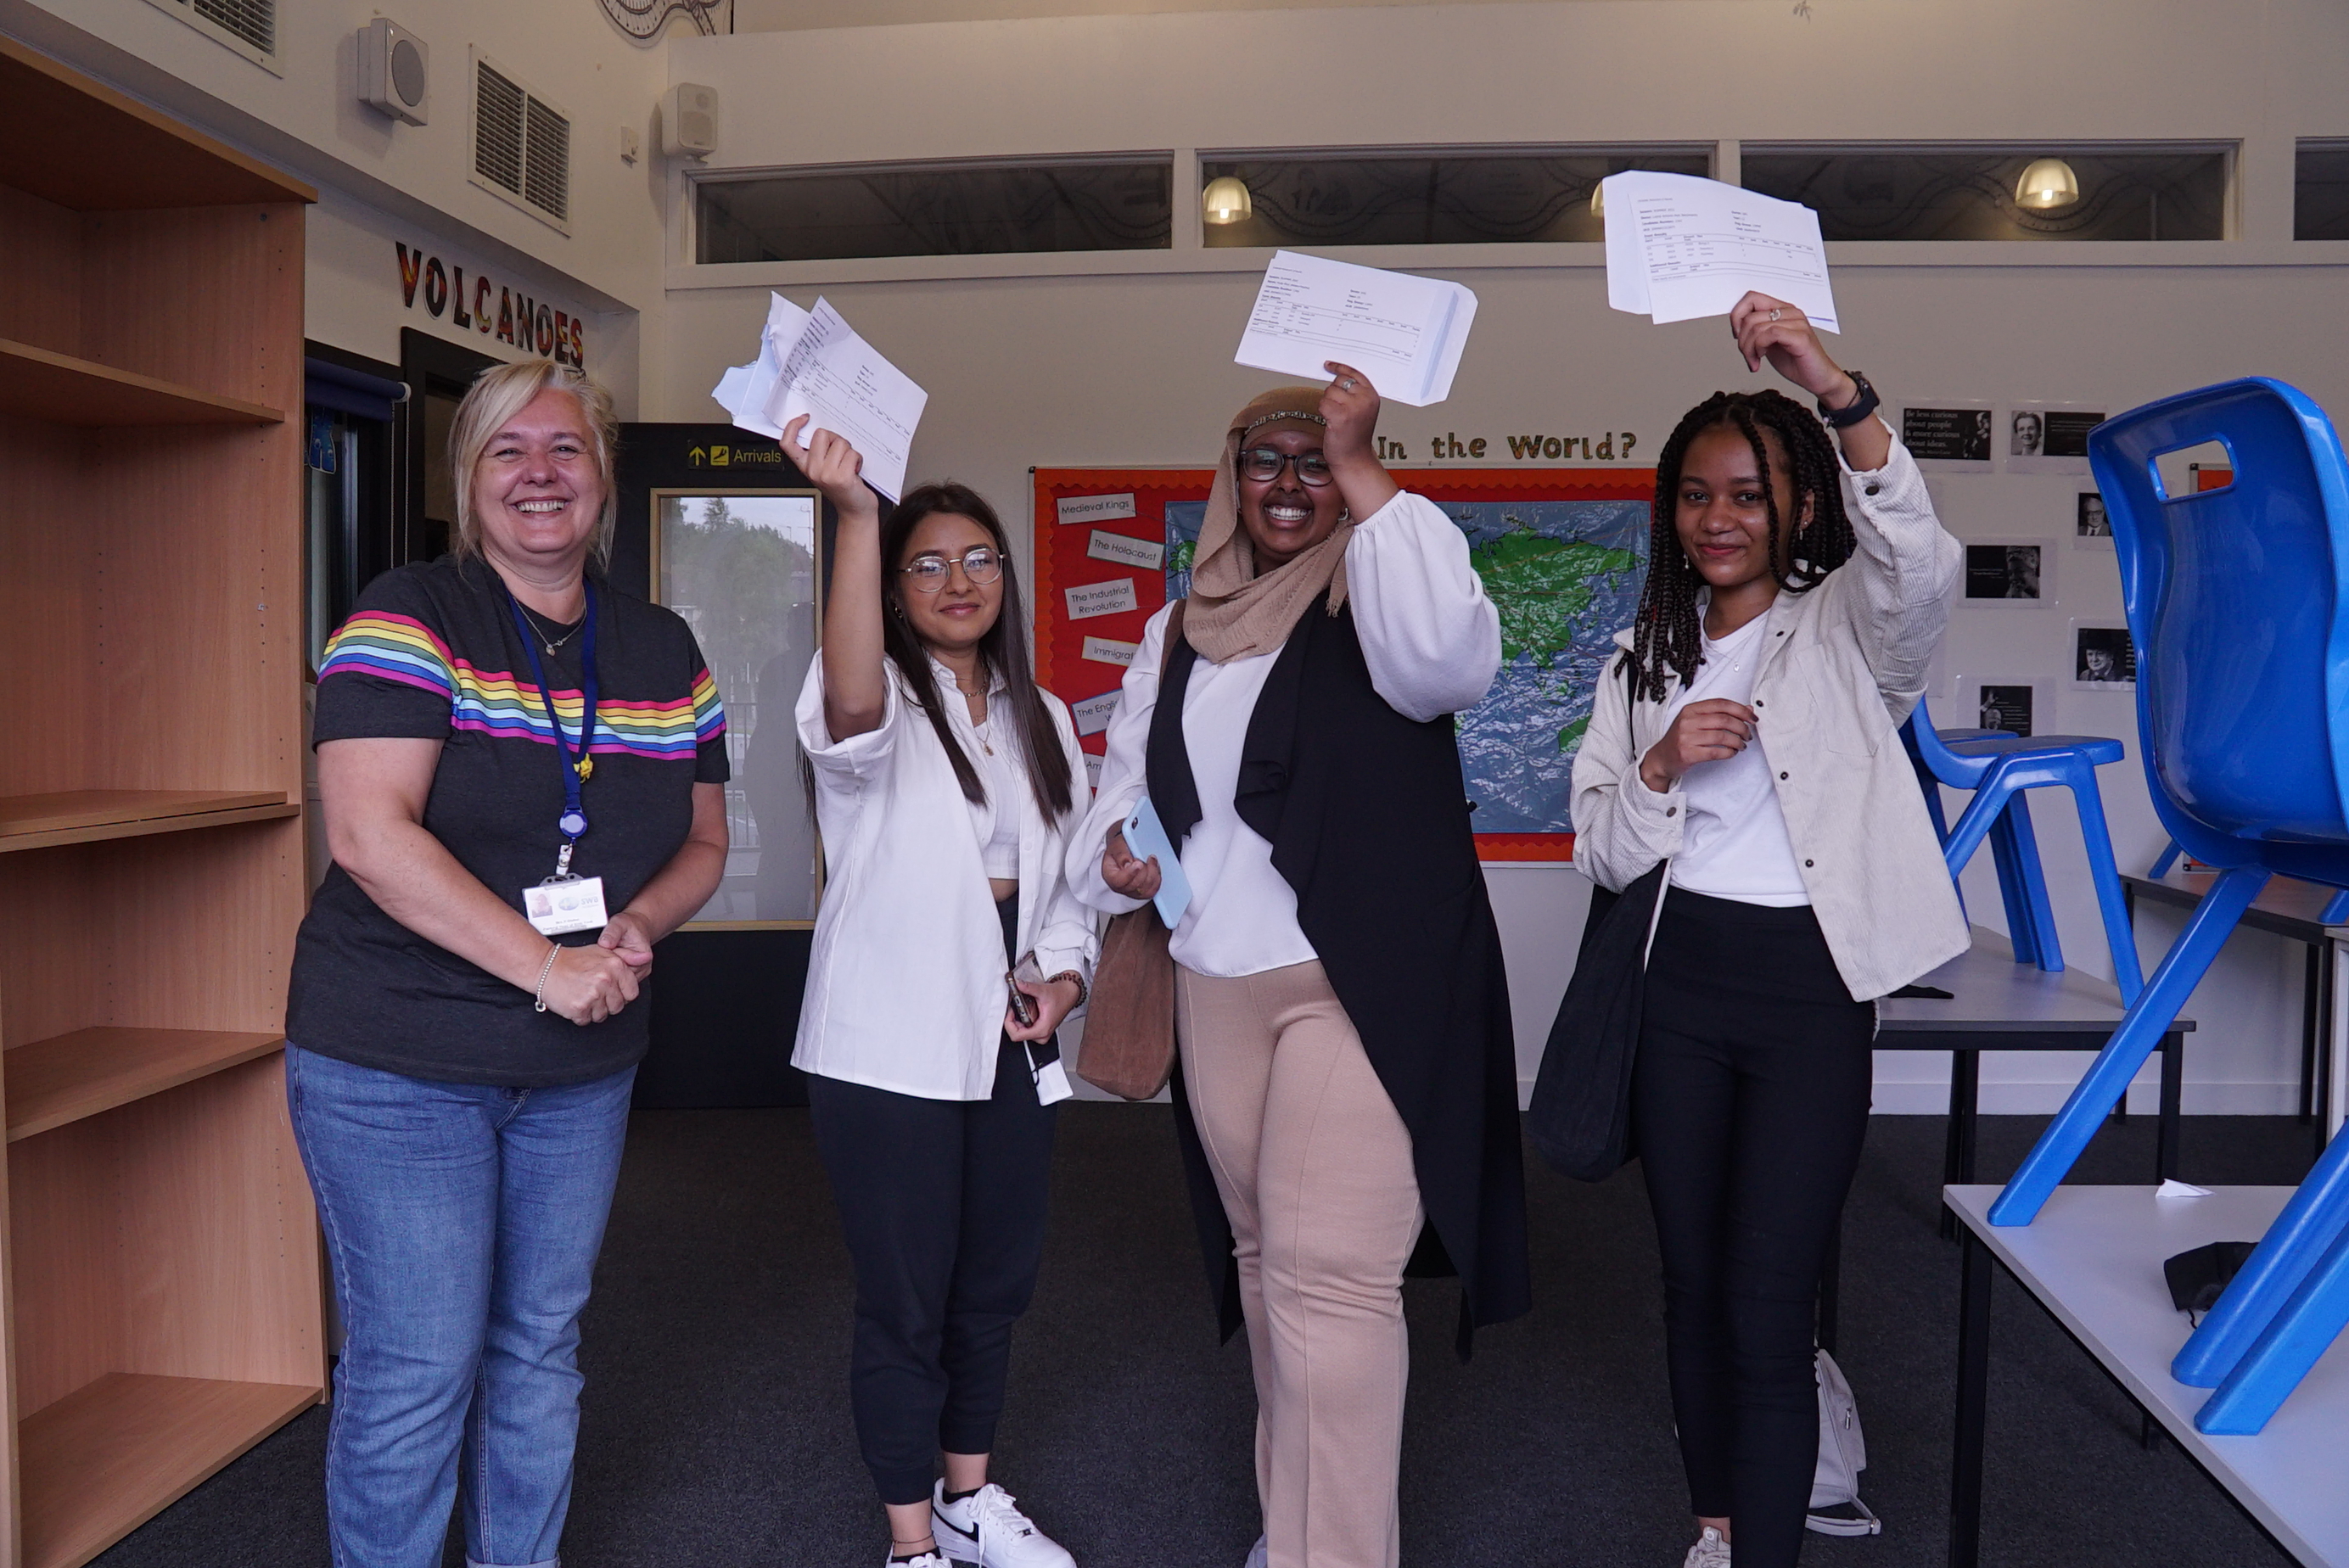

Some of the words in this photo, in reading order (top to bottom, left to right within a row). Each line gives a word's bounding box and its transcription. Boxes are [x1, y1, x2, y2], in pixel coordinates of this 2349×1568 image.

[395, 241, 584, 369] VOLCANOES
[1377, 436, 1408, 460] In
[1432, 432, 1487, 459] the
[1507, 432, 1637, 460] World?
[733, 449, 782, 463] Arrivals
[1061, 501, 1103, 514] Medieval
[1106, 500, 1130, 510] Kings
[1094, 539, 1109, 550] The
[1111, 543, 1157, 561] Holocaust
[1071, 594, 1087, 602] The
[1089, 585, 1130, 599] Industrial
[1079, 600, 1126, 614] Revolution
[1094, 646, 1135, 660] Immigrat
[1077, 708, 1093, 718] The
